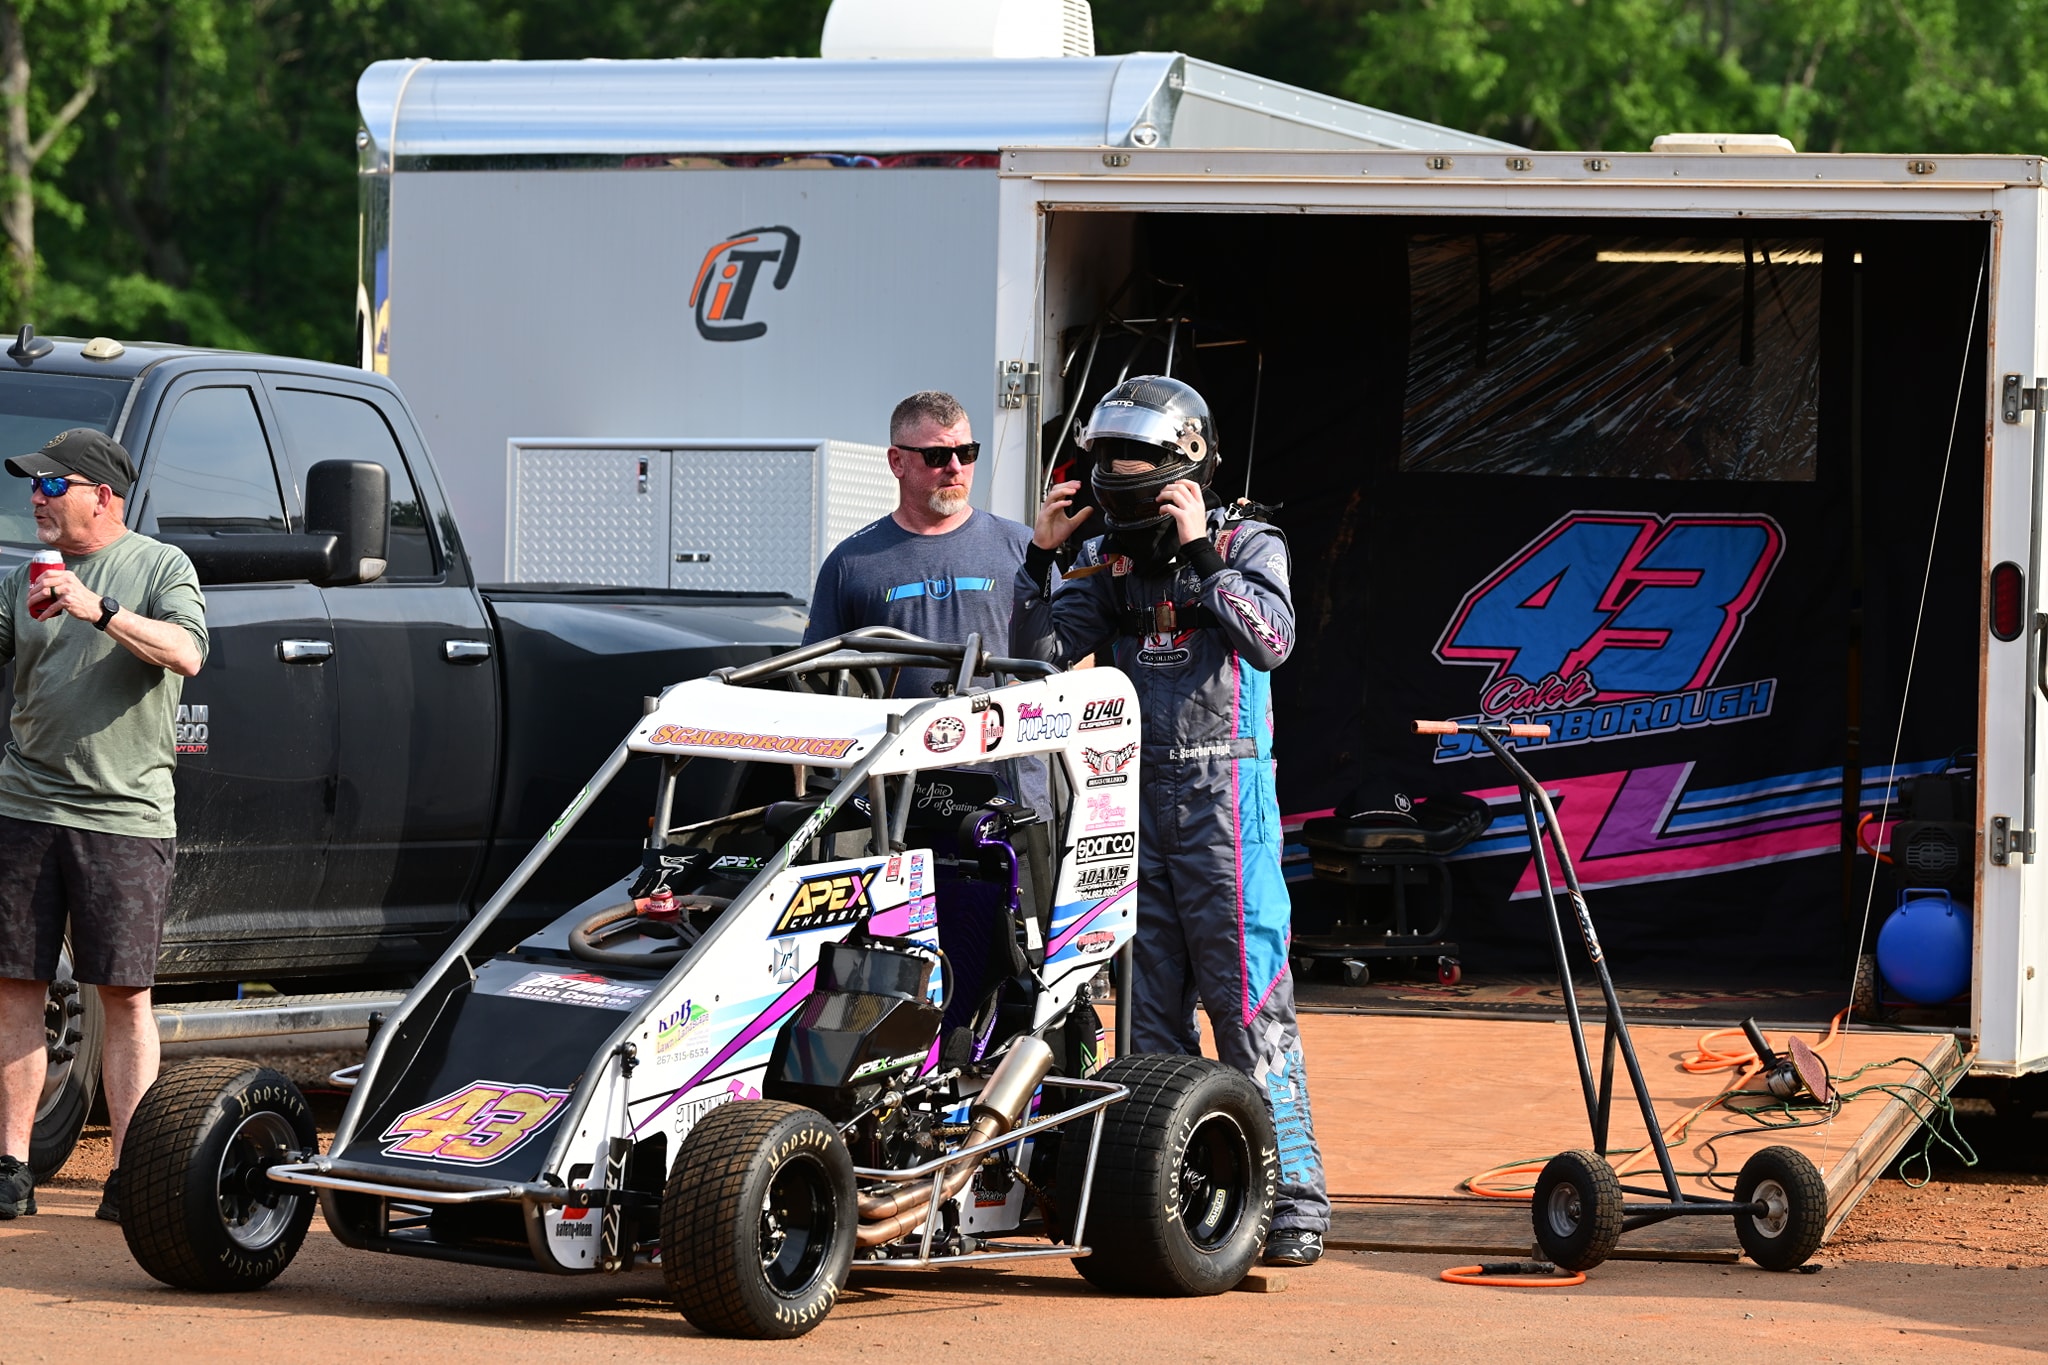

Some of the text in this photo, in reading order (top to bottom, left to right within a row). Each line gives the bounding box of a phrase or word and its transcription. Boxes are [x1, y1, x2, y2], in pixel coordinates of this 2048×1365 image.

[1438, 514, 1781, 698] 43
[1083, 698, 1125, 720] 8740
[1482, 670, 1597, 718] Caleb
[175, 704, 209, 722] AM
[1017, 713, 1071, 742] POP-POP
[652, 724, 856, 758] SCARBOROUGH
[1180, 742, 1231, 759] Scarborough
[934, 799, 978, 816] of Seating
[1077, 834, 1134, 862] sparco
[1075, 865, 1129, 887] ADAMS
[776, 872, 874, 931] APEX
[790, 907, 869, 929] CHASSIS
[508, 984, 561, 997] Auto
[560, 988, 633, 1006] Center
[658, 999, 691, 1033] KDB
[236, 1084, 305, 1118] Hoosier
[385, 1083, 571, 1163] 43
[767, 1122, 833, 1171] Hoosier
[1164, 1117, 1192, 1223] Hoosier
[1254, 1146, 1276, 1249] Hoosier
[555, 1220, 592, 1240] safety-kleen
[220, 1241, 288, 1277] Hoosier
[775, 1273, 840, 1332] Hoosier
